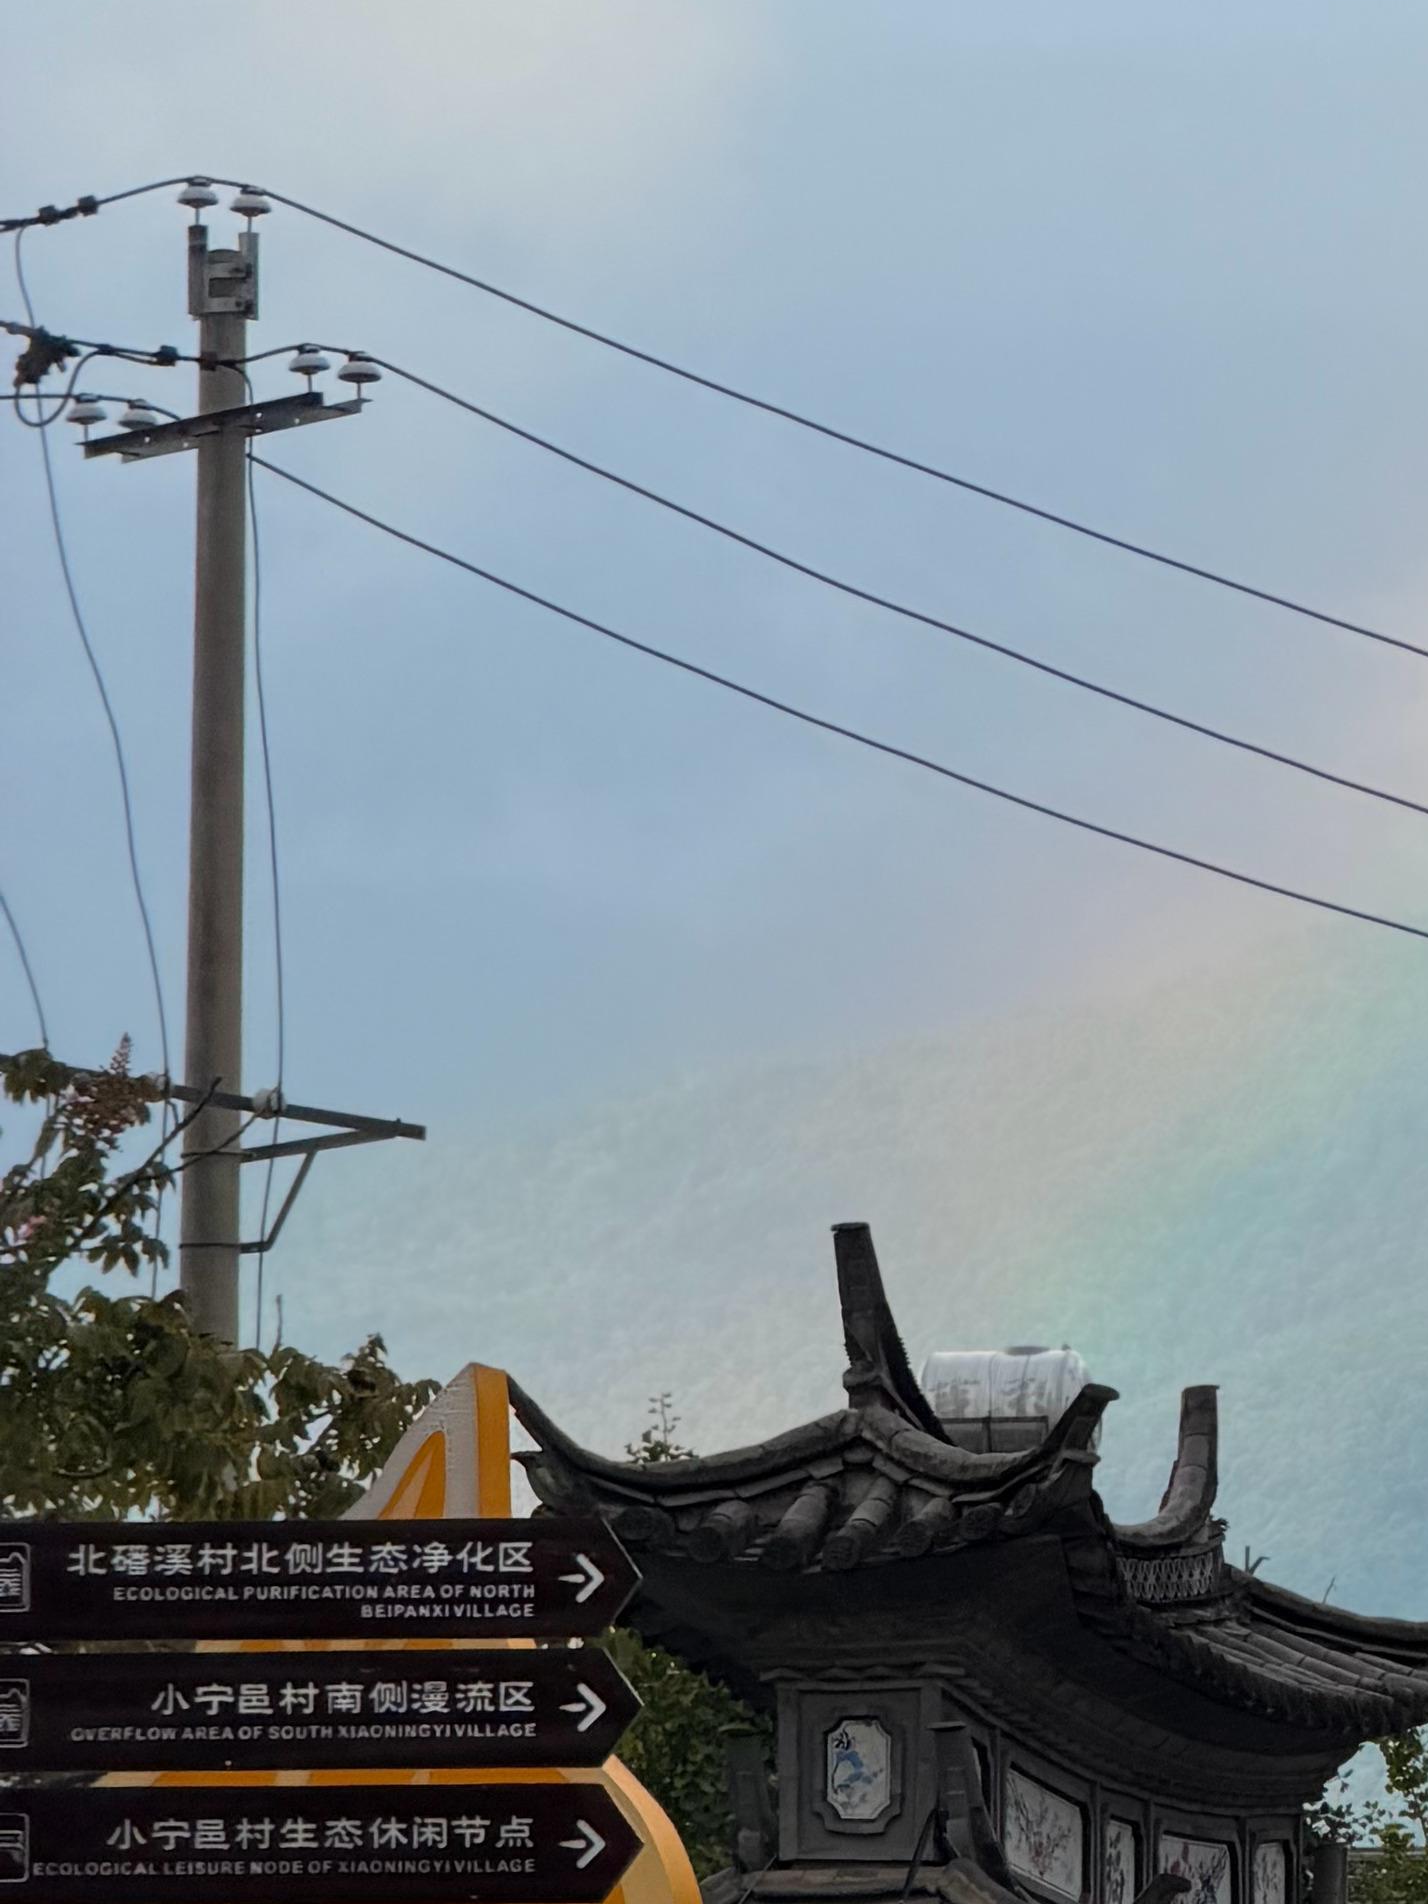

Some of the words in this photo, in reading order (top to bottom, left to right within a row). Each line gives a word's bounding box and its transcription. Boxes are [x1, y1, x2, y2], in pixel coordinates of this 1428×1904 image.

[113, 1586, 239, 1601] ECOLOGICAL
[243, 1585, 379, 1600] PURIFICATION
[382, 1584, 436, 1600] AREA
[439, 1584, 466, 1599] OF
[469, 1584, 535, 1599] NORTH
[360, 1603, 450, 1619] BEIPANXI
[453, 1603, 535, 1618] VILLAGE
[151, 1681, 535, 1716] 小宁邑村南侧漫流区
[70, 1726, 177, 1742] OVERFLOW
[181, 1725, 235, 1741] AREA
[237, 1725, 263, 1741] OF
[268, 1724, 333, 1741] SOUTH
[338, 1723, 451, 1740] XIAONINGYI
[453, 1722, 537, 1739] VILLAGE
[106, 1816, 534, 1851] 小宁邑村生态休闲节点
[32, 1860, 158, 1877] ECOLOGICAL
[162, 1860, 245, 1876] LEISURE
[249, 1860, 304, 1875] NODE
[307, 1859, 333, 1875] OF
[338, 1858, 451, 1875] XIAONINGYI
[453, 1857, 535, 1873] VILLAGE
